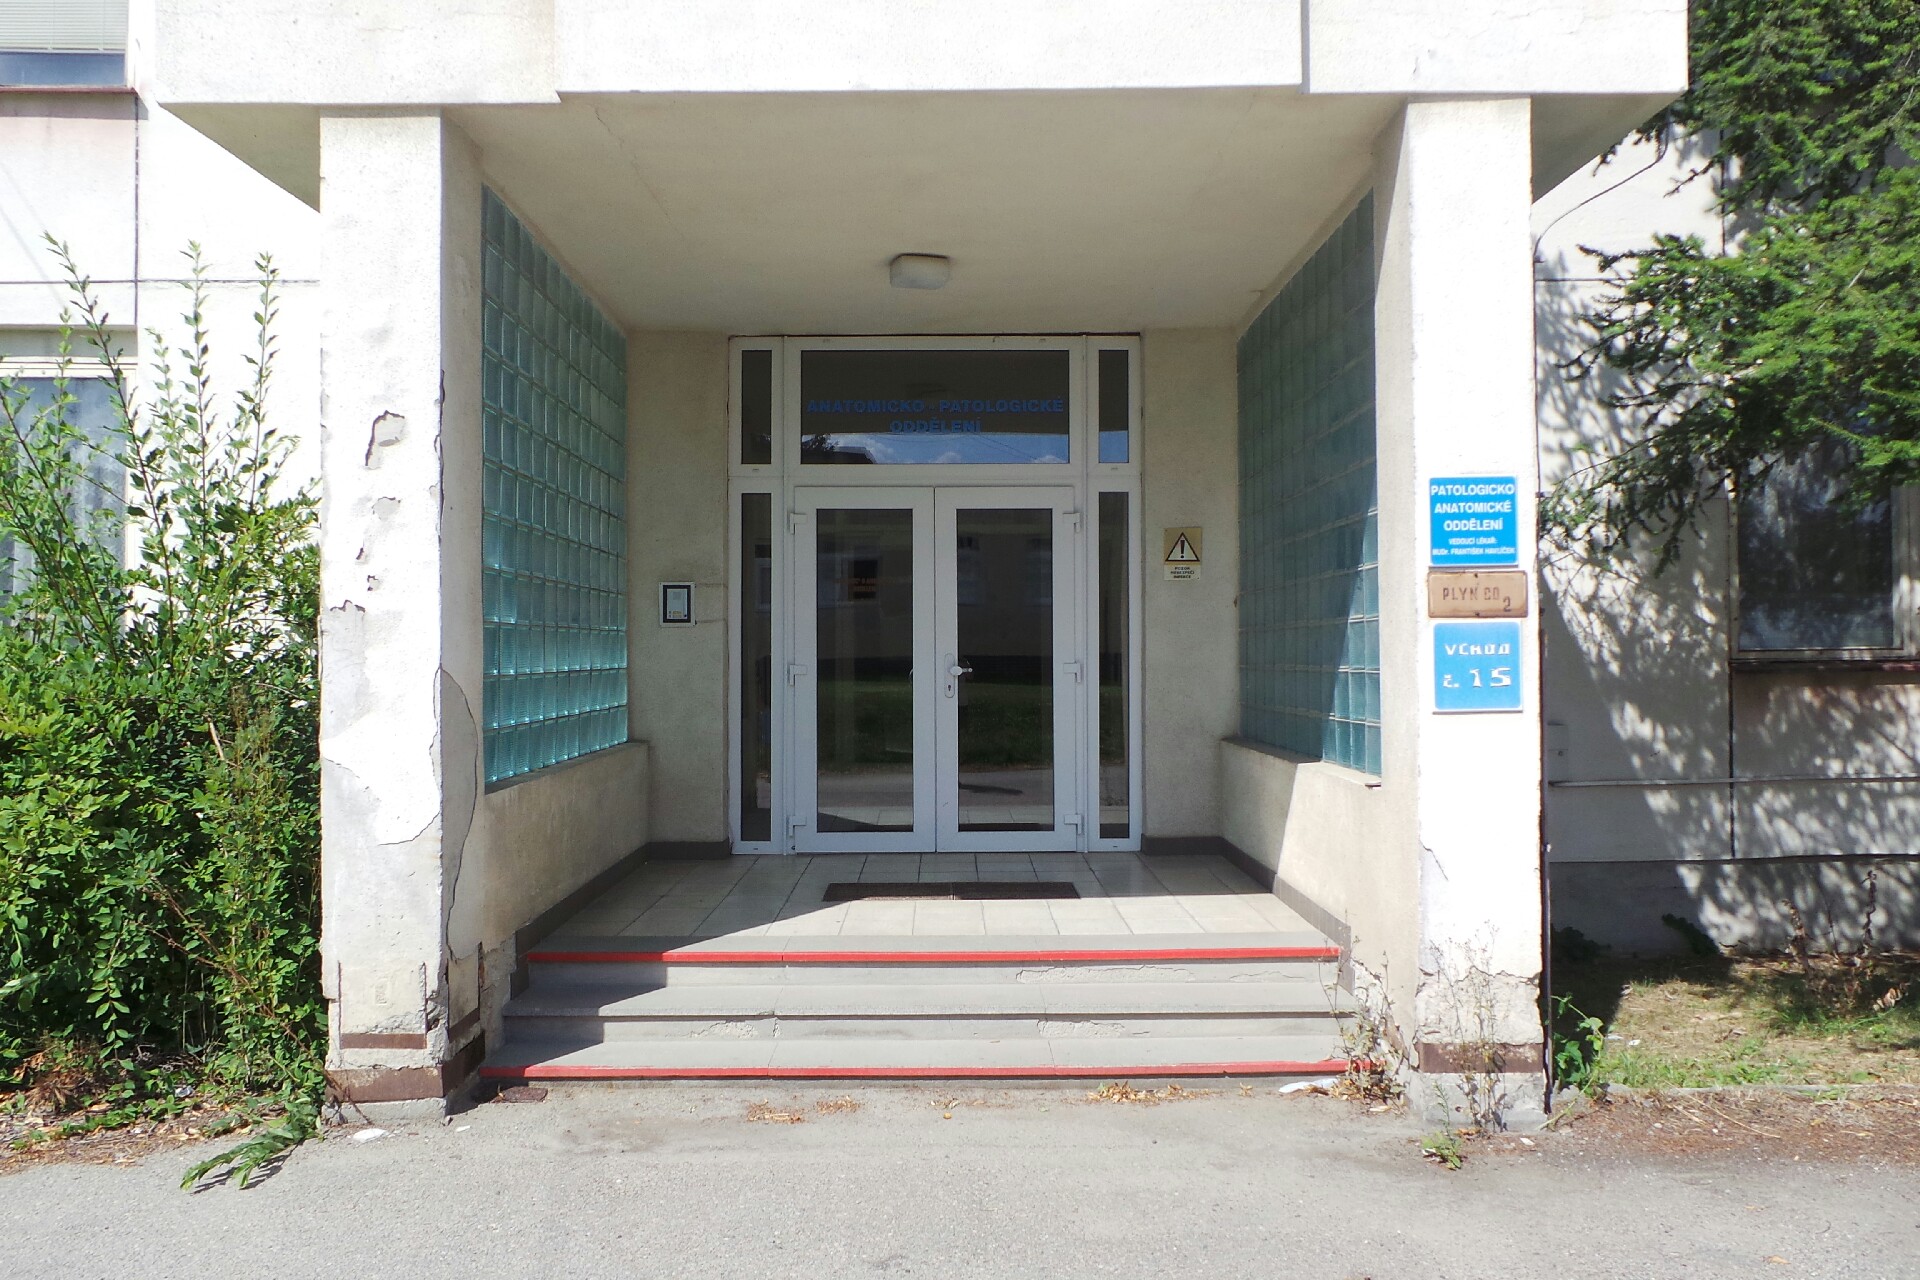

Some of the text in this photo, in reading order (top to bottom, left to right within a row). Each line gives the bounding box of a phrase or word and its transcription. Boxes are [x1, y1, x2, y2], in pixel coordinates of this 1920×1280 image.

[806, 399, 925, 413] ANATOMICKO
[939, 396, 1065, 413] PATOLOGICKÉ
[889, 416, 982, 433] ODDĚLENÍ
[1430, 484, 1515, 496] PATOLOGICKO
[1434, 500, 1512, 513] ANATOMICKÉ
[1443, 518, 1504, 531] ODDĚLENÍ
[1442, 587, 1478, 600] PLYN
[1444, 643, 1511, 656] VCHOD
[1469, 667, 1512, 688] 15
